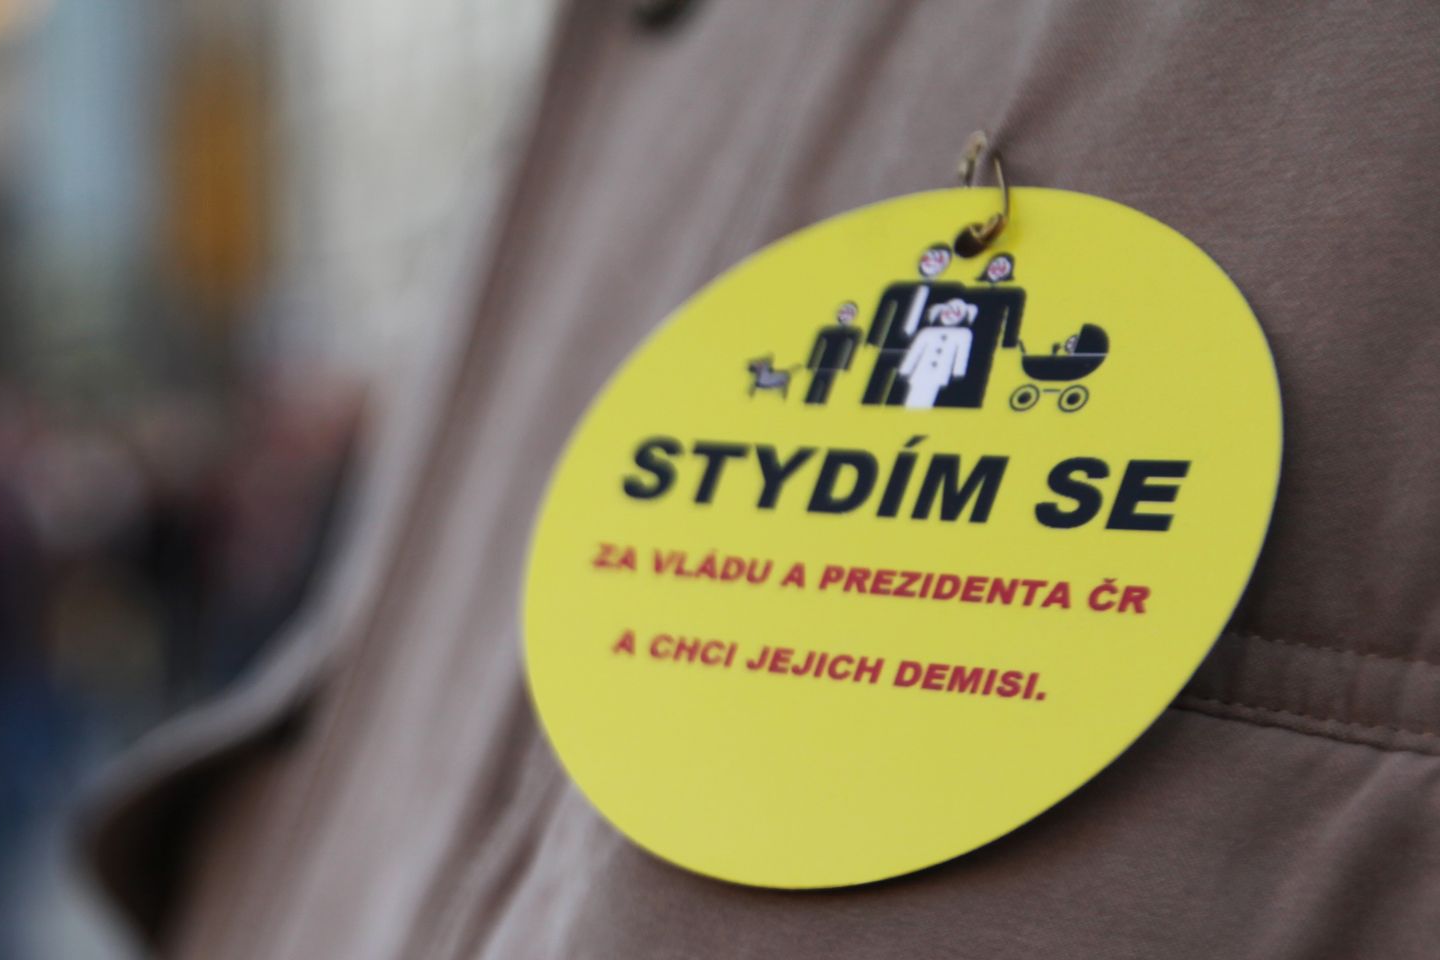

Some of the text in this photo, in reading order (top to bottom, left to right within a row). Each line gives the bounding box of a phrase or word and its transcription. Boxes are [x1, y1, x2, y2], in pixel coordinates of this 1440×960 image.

[621, 434, 1192, 533] STYDÍM SE
[591, 543, 1152, 616] ZA VLÁDU A PREZIDENTA ČR
[612, 629, 1048, 703] A CHCI JEJICH DEMISI.
